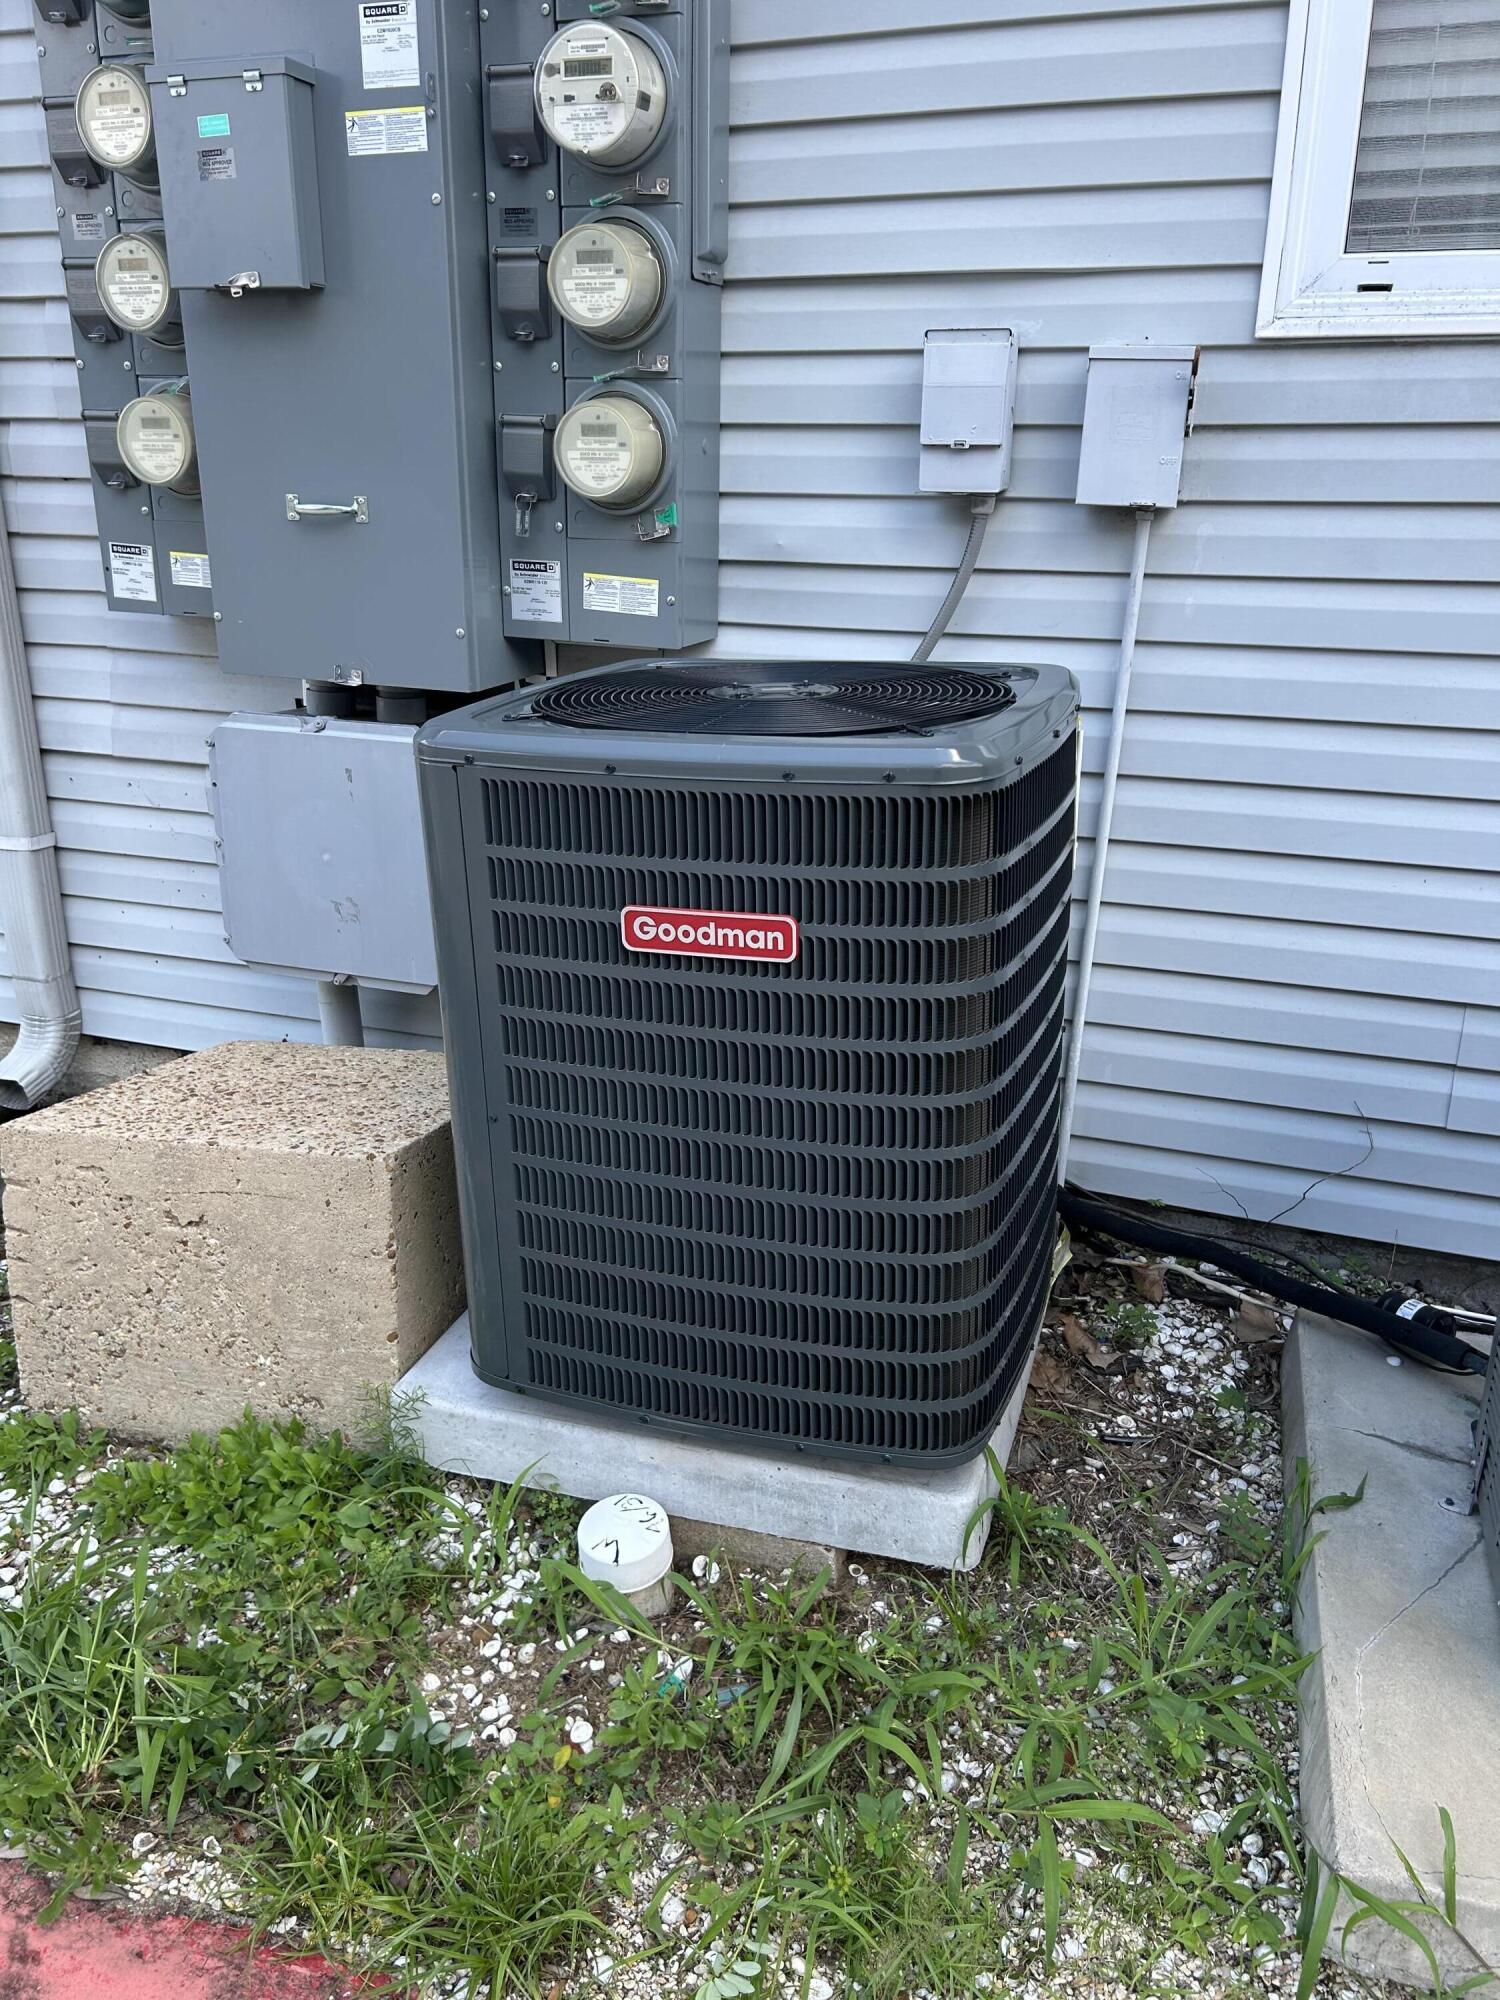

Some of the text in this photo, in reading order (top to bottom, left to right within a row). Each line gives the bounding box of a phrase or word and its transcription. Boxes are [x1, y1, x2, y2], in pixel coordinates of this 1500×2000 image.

[364, 5, 398, 16] SQUARE
[112, 545, 141, 554] SQUARE
[514, 562, 546, 571] SQUARE
[633, 915, 784, 950] Goodman
